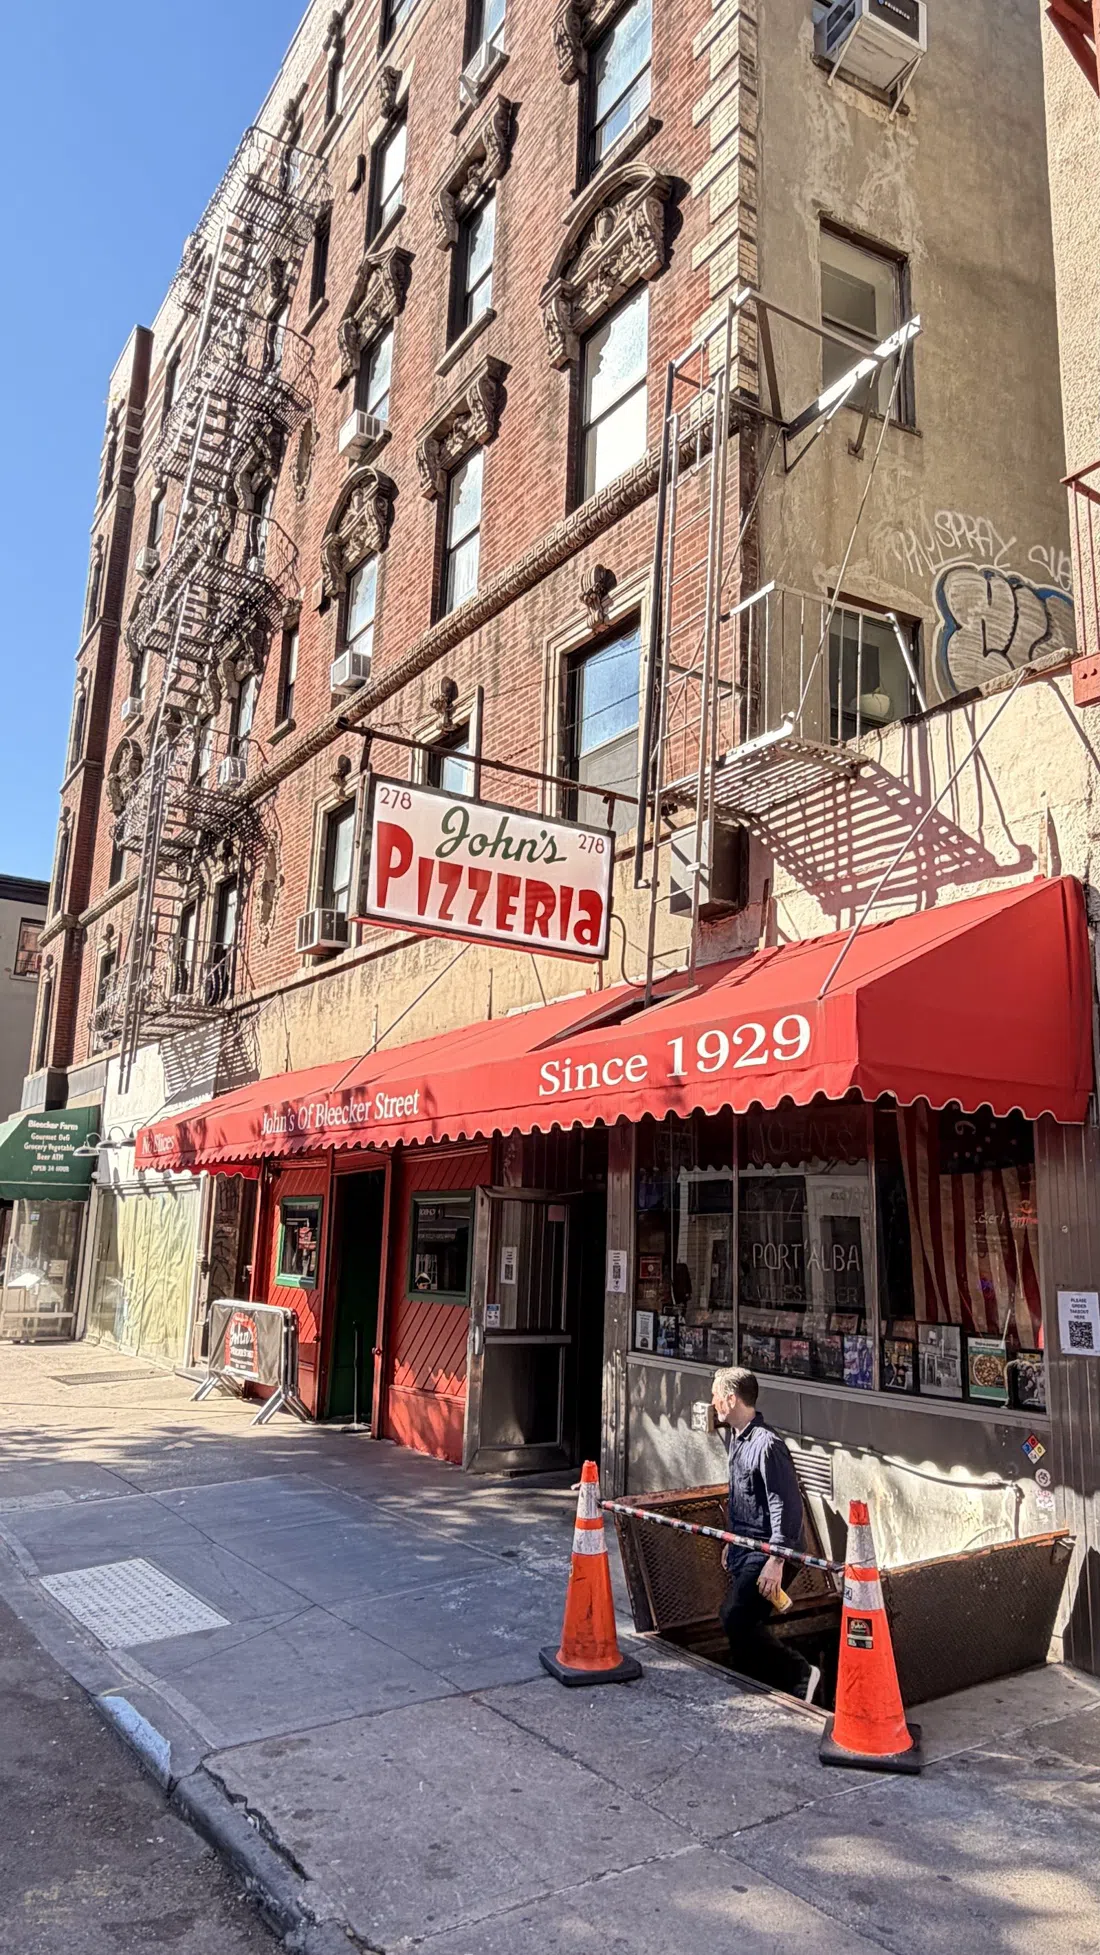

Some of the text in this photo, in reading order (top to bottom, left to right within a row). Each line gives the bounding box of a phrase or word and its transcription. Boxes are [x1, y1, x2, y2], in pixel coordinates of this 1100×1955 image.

[379, 787, 412, 810] 278
[435, 805, 567, 864] John's
[578, 833, 605, 855] 278
[538, 1013, 811, 1097] Since 1929
[261, 1088, 420, 1135] John's Of Bleecker Street
[59, 1122, 78, 1130] Farm
[24, 1142, 47, 1152] Grocery
